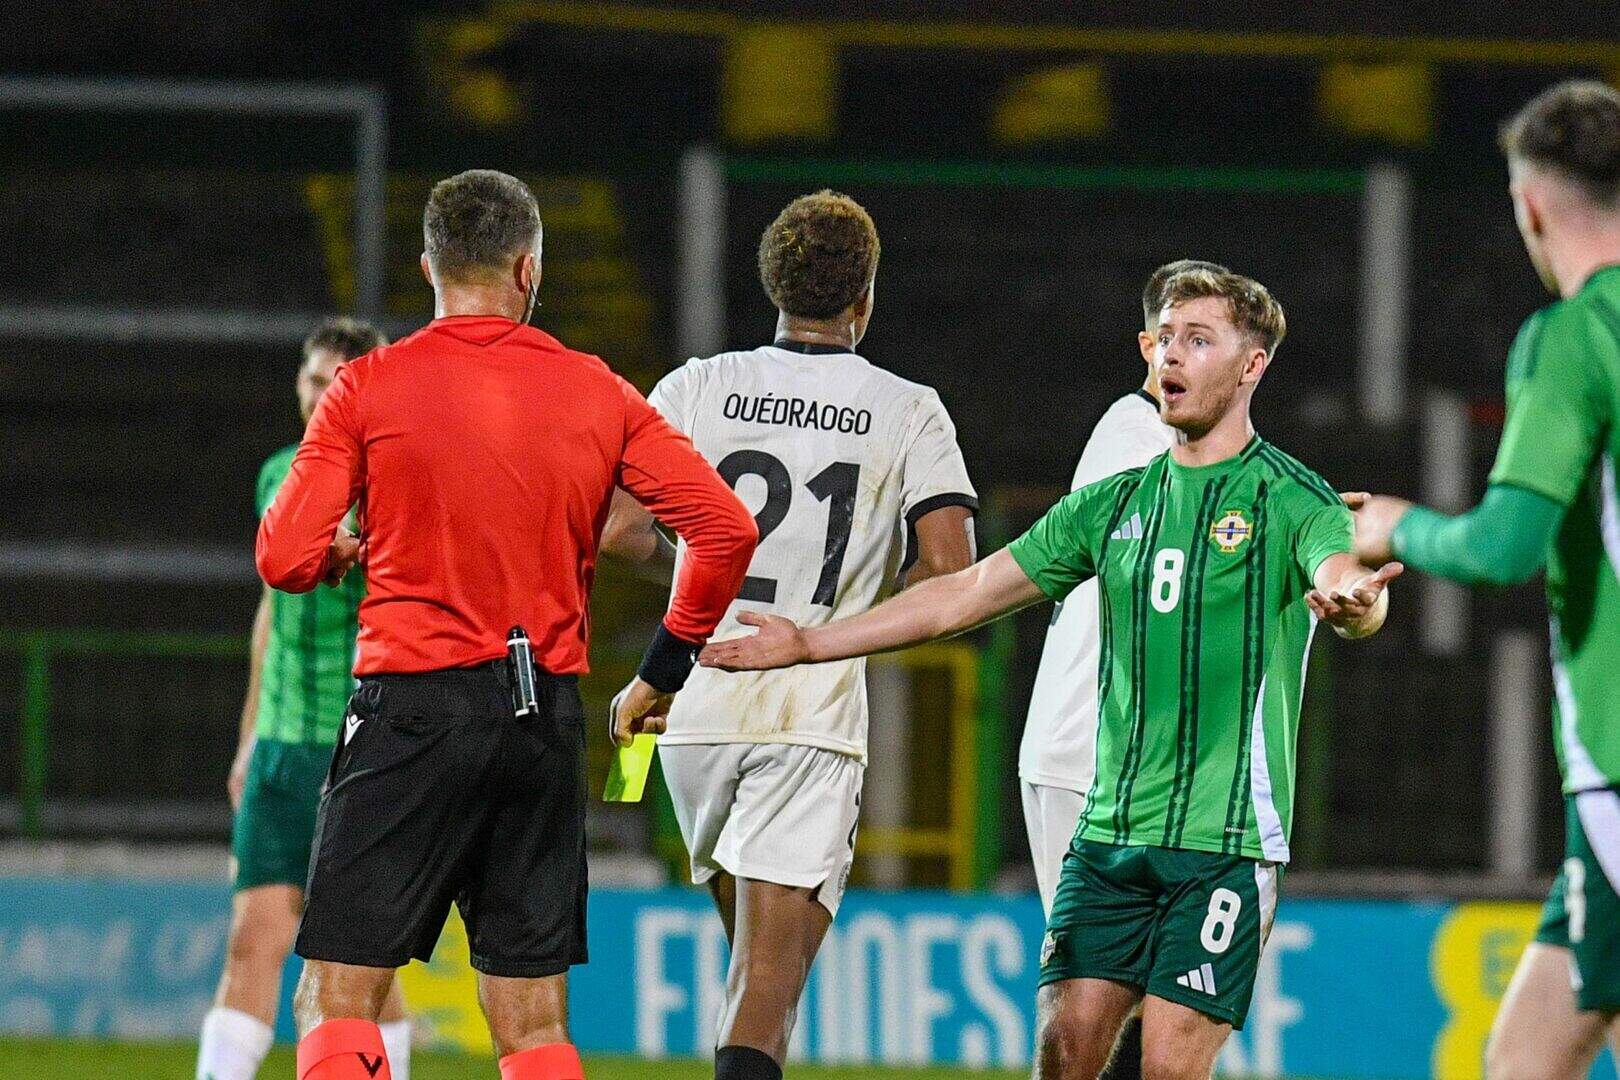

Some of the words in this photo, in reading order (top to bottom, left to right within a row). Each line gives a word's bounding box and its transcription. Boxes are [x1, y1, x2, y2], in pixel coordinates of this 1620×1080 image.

[723, 392, 872, 435] OUÉDRAOGO
[716, 449, 861, 607] 21
[1150, 548, 1185, 614] 8
[1200, 887, 1242, 954] 8
